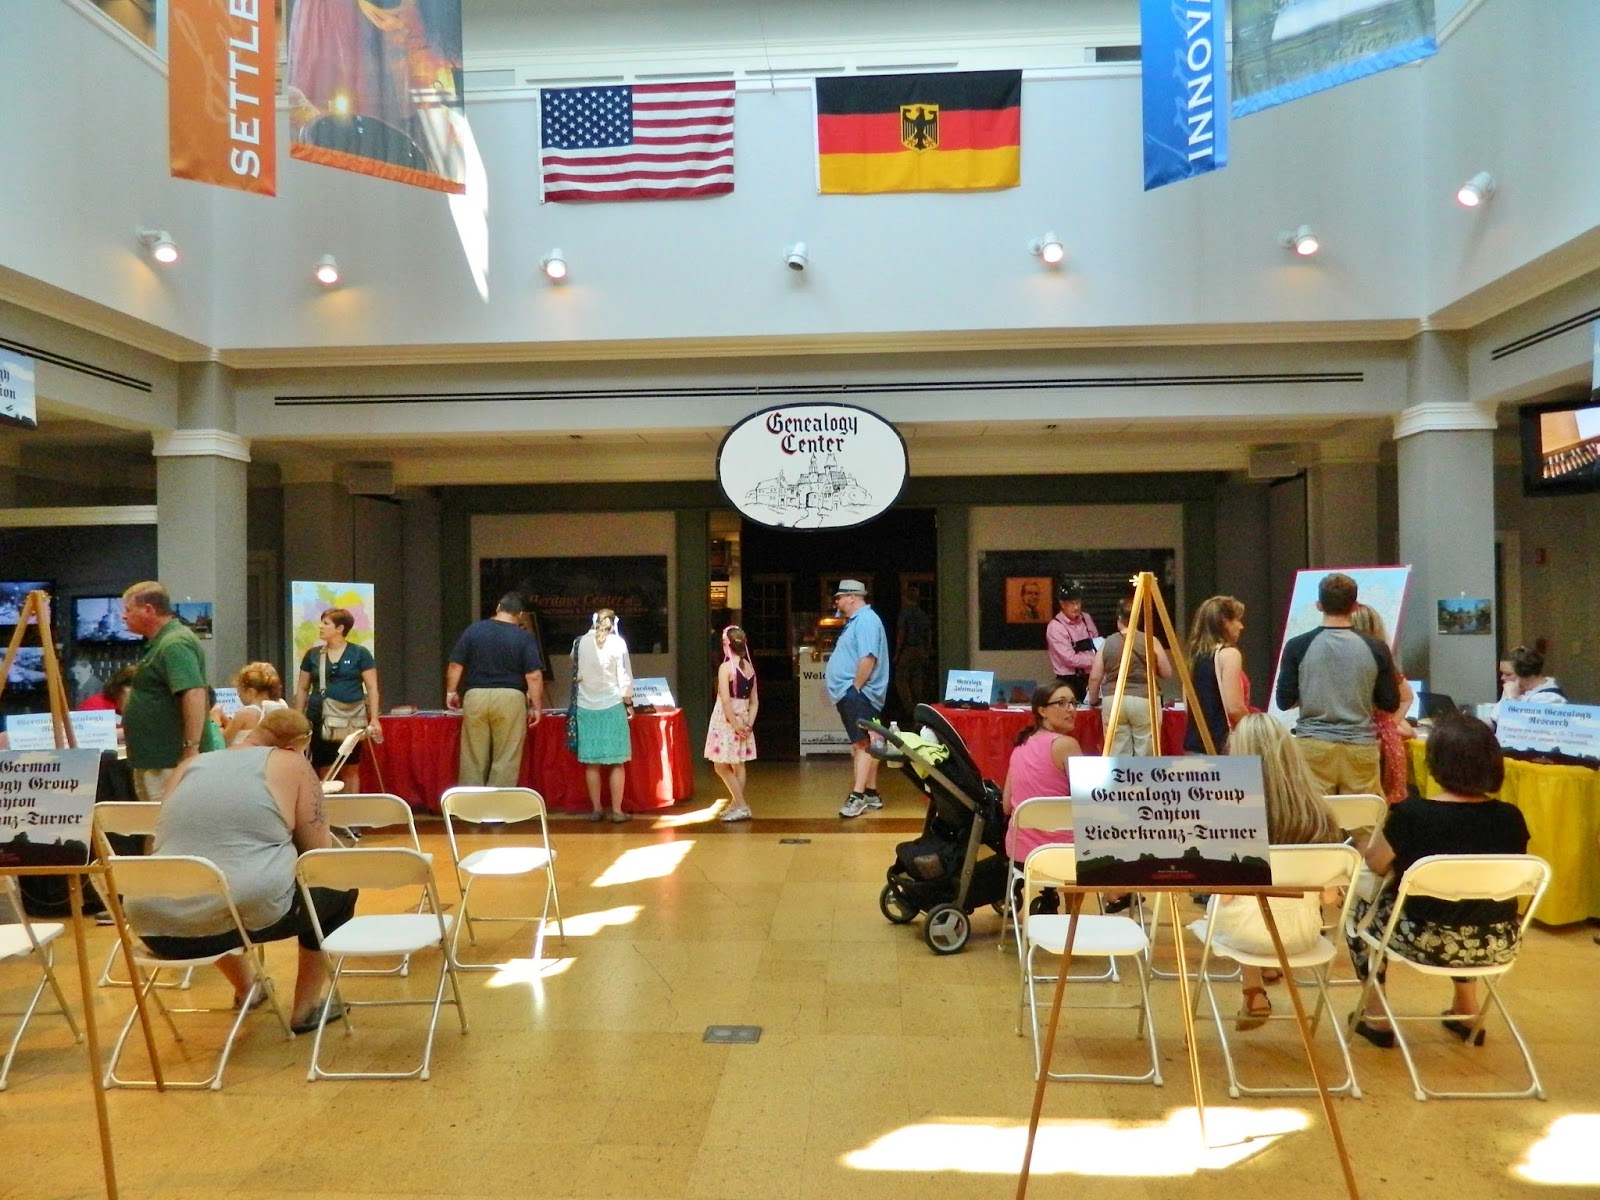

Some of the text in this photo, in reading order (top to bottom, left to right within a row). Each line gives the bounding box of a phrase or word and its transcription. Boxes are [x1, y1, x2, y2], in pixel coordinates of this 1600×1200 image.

[229, 0, 260, 179] SETTLE
[766, 412, 858, 435] Genealogy
[780, 434, 845, 455] Center
[1508, 705, 1592, 719] German Genealogy
[1528, 717, 1569, 727] Research
[0, 760, 61, 774] German
[1111, 767, 1221, 785] The German
[28, 776, 80, 793] Group
[1091, 786, 1245, 805] Genealogy Group
[1137, 805, 1201, 824] Dayton
[1084, 824, 1257, 844] Liederkranz-Turner
